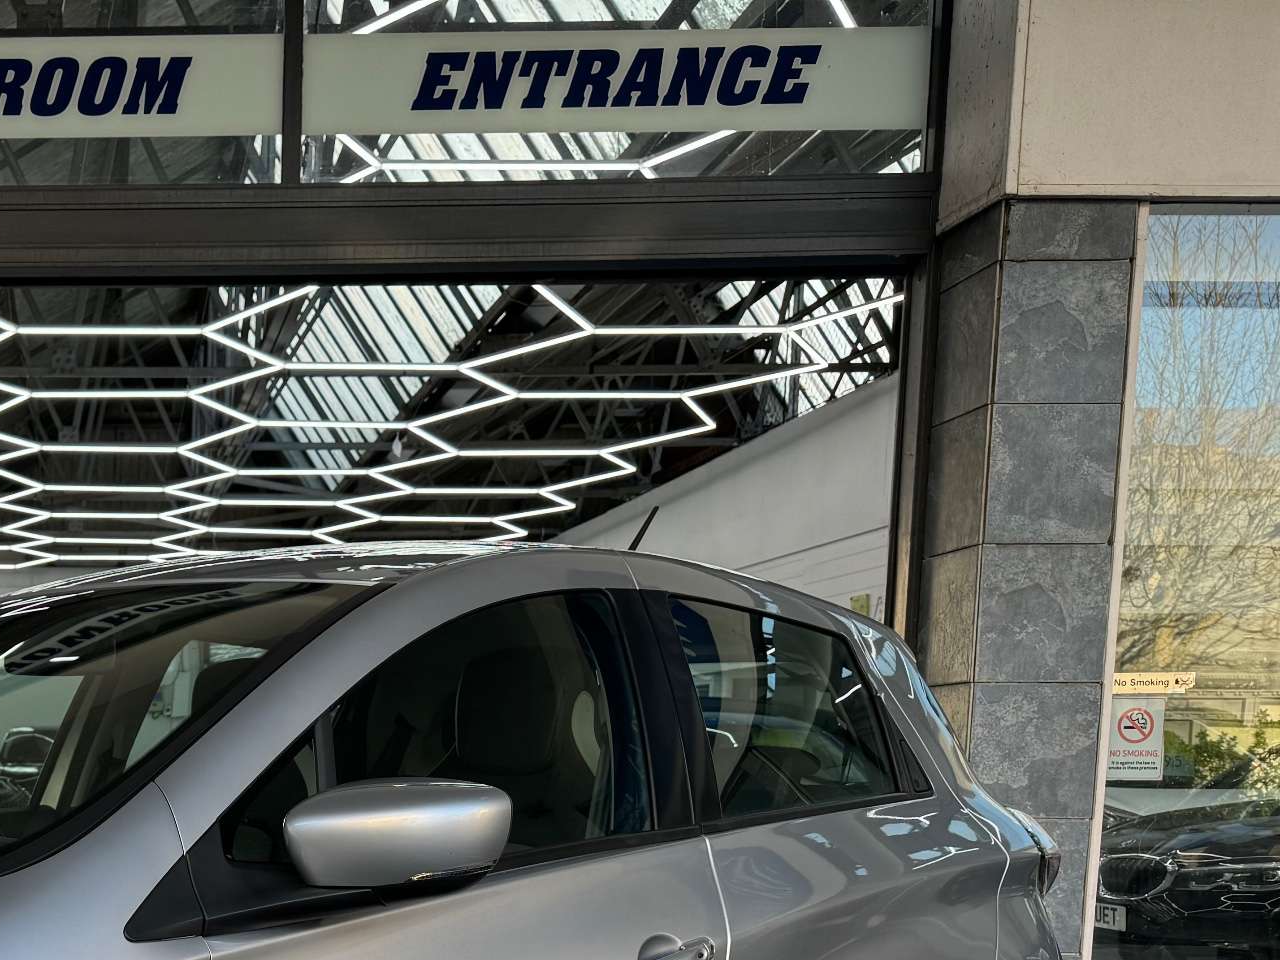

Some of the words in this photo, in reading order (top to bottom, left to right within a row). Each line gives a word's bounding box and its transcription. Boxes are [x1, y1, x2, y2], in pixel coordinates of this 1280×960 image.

[410, 45, 822, 111] ENTRANCE
[1130, 678, 1170, 688] Smoking
[1109, 750, 1121, 758] NO
